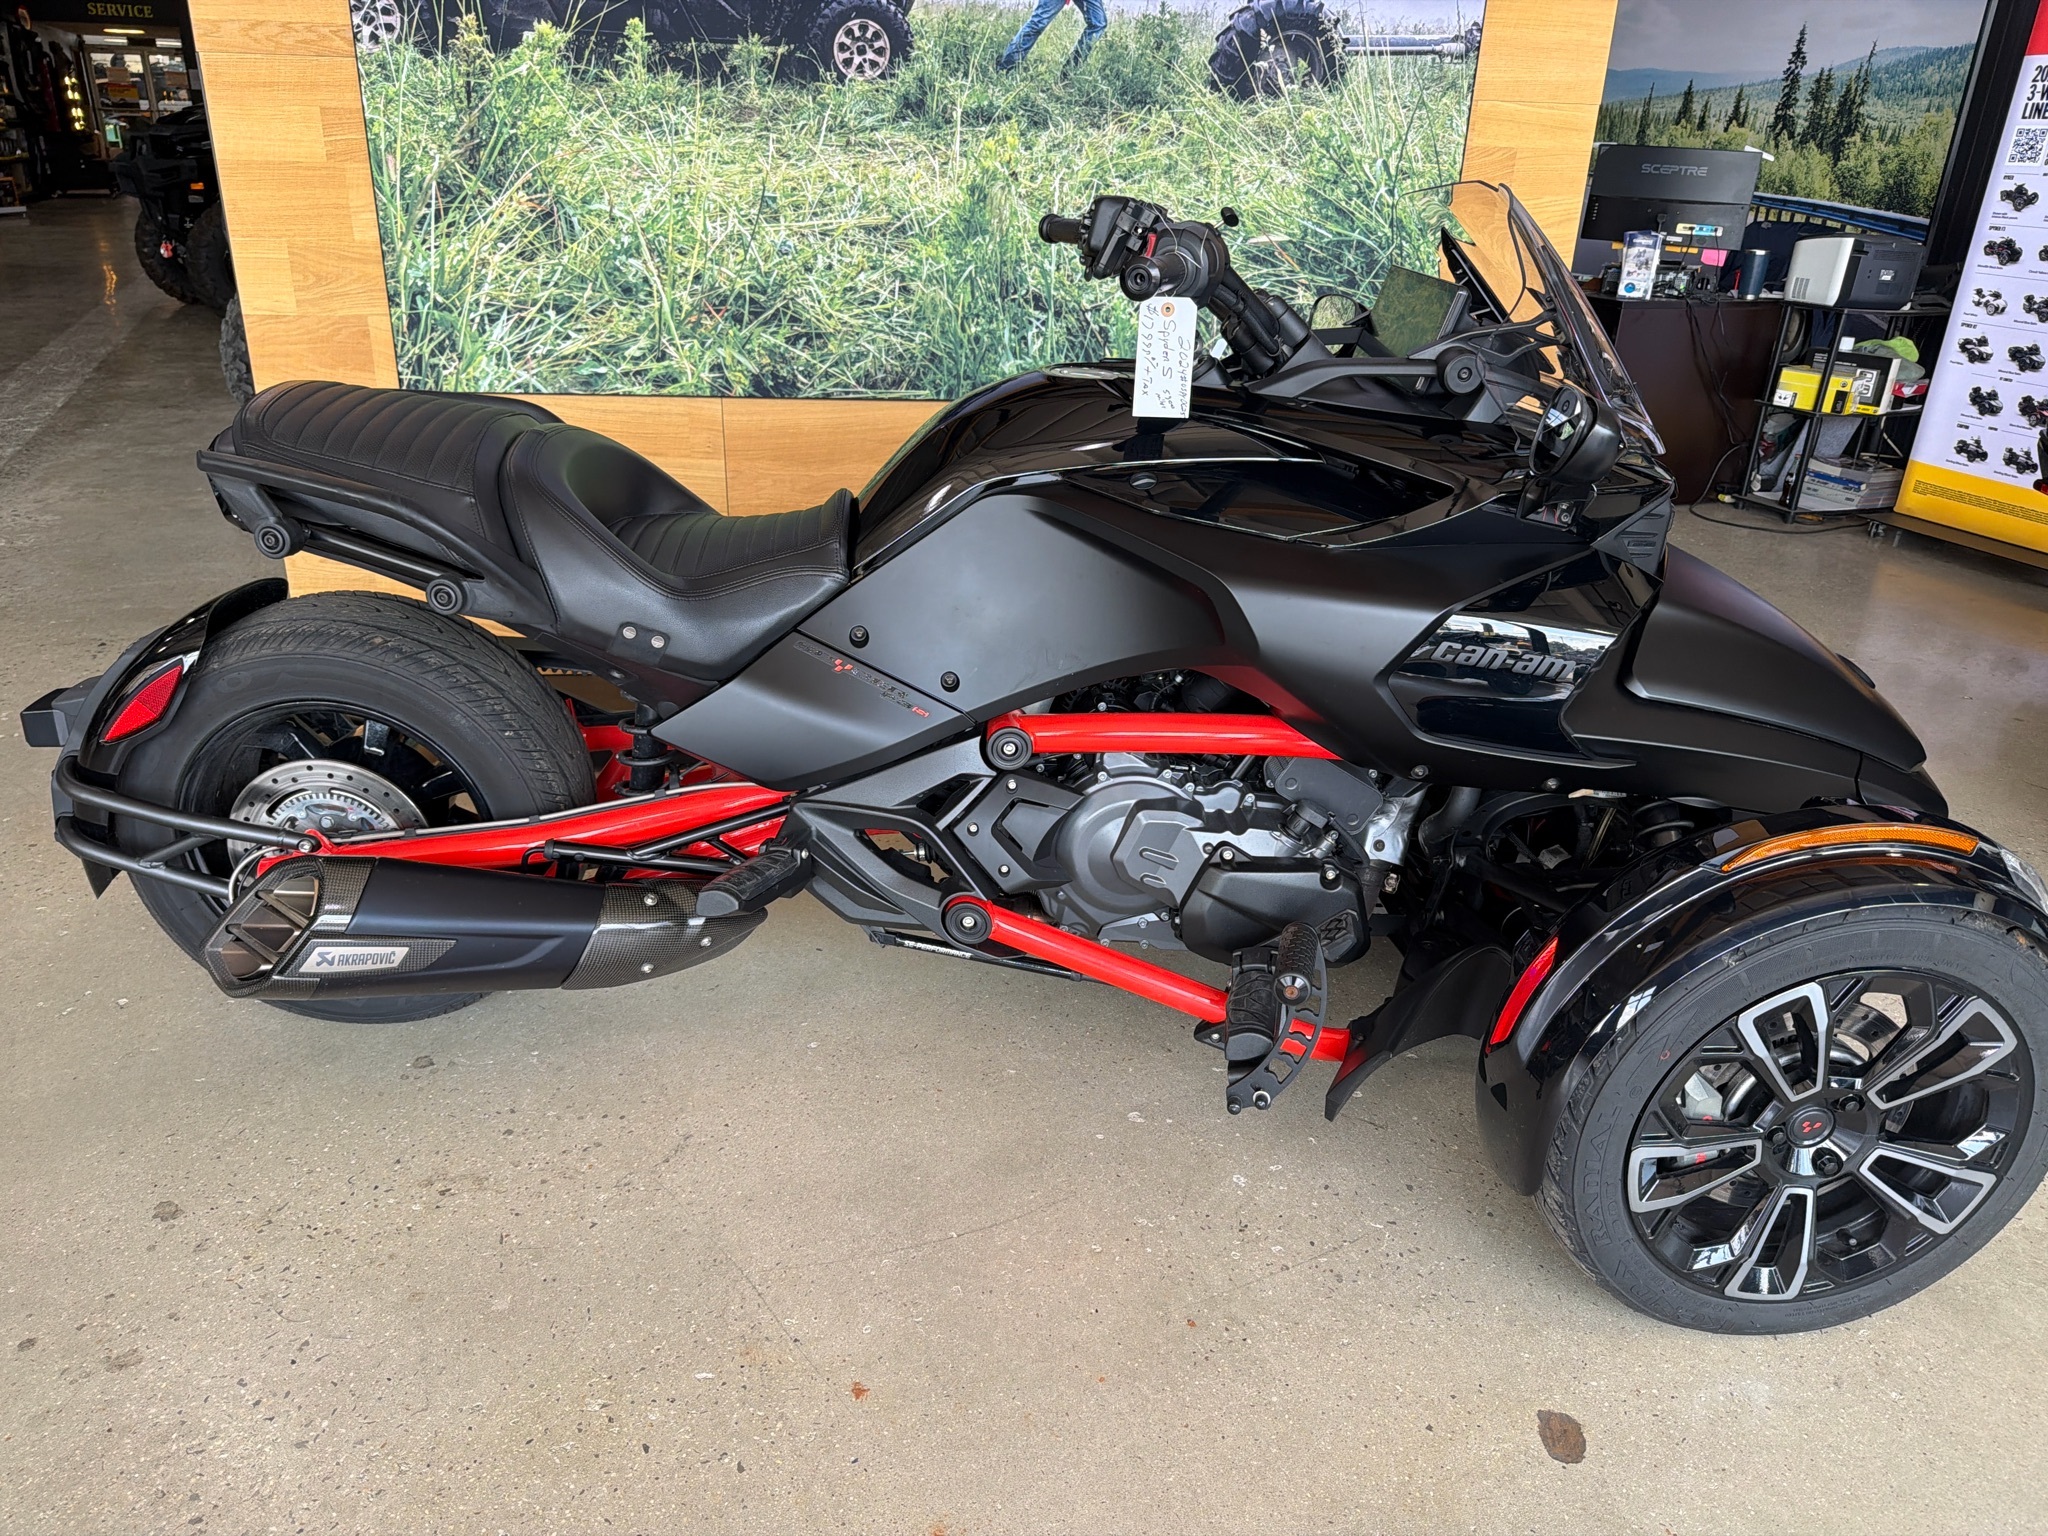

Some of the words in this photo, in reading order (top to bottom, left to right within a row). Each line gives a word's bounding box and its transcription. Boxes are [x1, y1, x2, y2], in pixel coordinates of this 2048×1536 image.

[87, 2, 153, 18] SERVICE
[1641, 163, 1709, 177] SCEPTRE
[903, 939, 974, 960] SE-PERFORMANCE
[336, 950, 397, 967] AKRAPOVIČ
[1582, 1104, 1623, 1248] RADIAL
